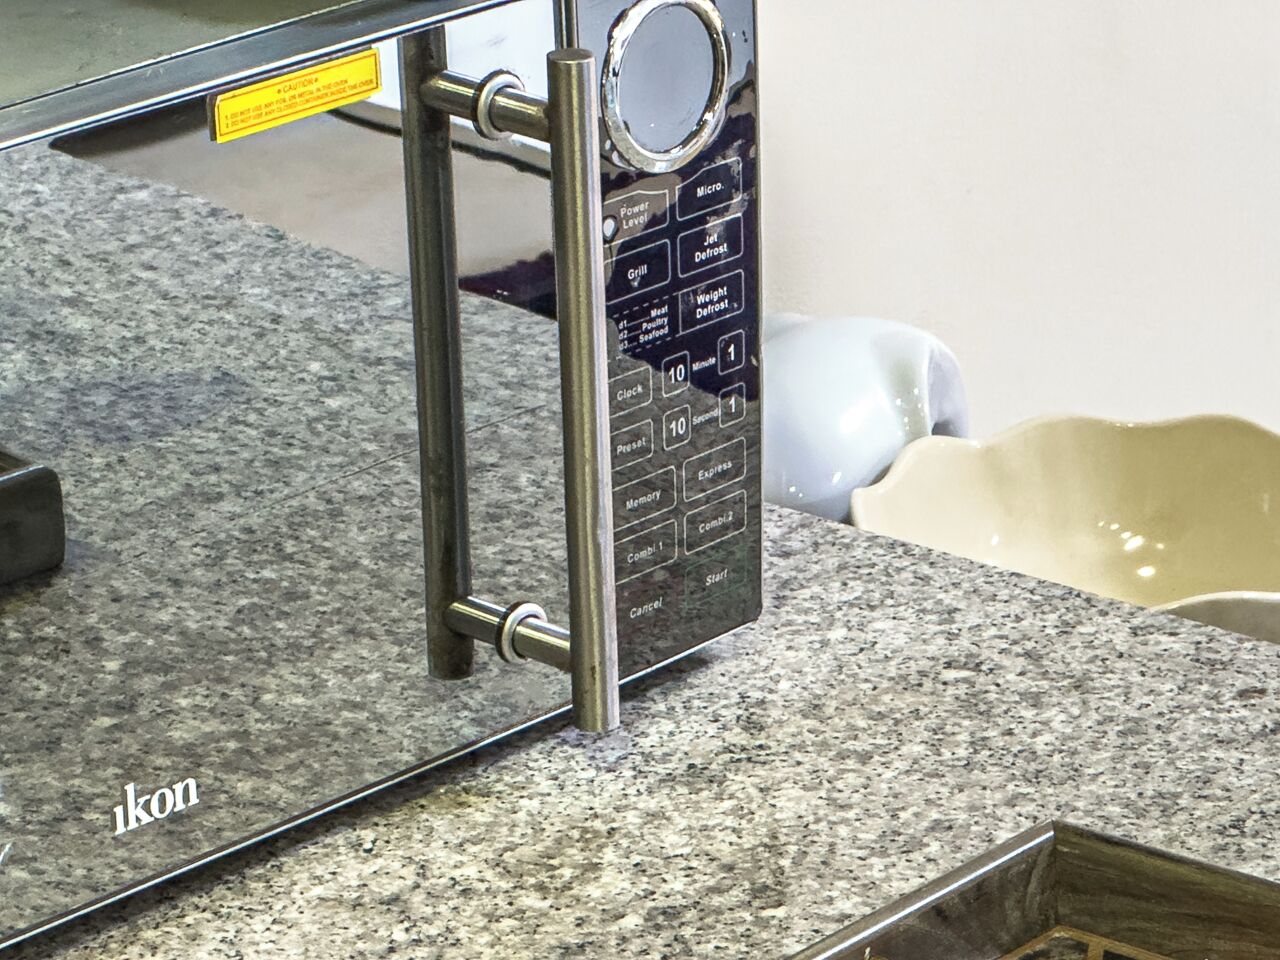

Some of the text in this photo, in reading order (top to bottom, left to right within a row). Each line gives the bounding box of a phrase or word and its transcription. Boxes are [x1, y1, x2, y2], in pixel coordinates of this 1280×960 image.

[283, 77, 314, 93] CAUTION
[697, 182, 725, 197] Micro.
[620, 201, 649, 218] Power
[622, 213, 649, 229] Level
[704, 233, 718, 246] Jet
[695, 243, 728, 262] Defrost
[627, 264, 648, 280] Grill
[697, 286, 728, 305] Weight
[696, 299, 729, 319] Defrost
[642, 315, 669, 332] Poultry
[639, 325, 669, 343] Seafood
[669, 343, 735, 384] 10 Minute 1
[616, 384, 643, 401] Clock
[669, 417, 686, 437] 10
[729, 396, 736, 413] 1
[616, 437, 646, 456] Preset
[698, 460, 733, 481] Express
[625, 489, 661, 511] Memory
[705, 568, 728, 587] Start
[630, 596, 663, 619] Cancel
[113, 777, 200, 836] ikon
